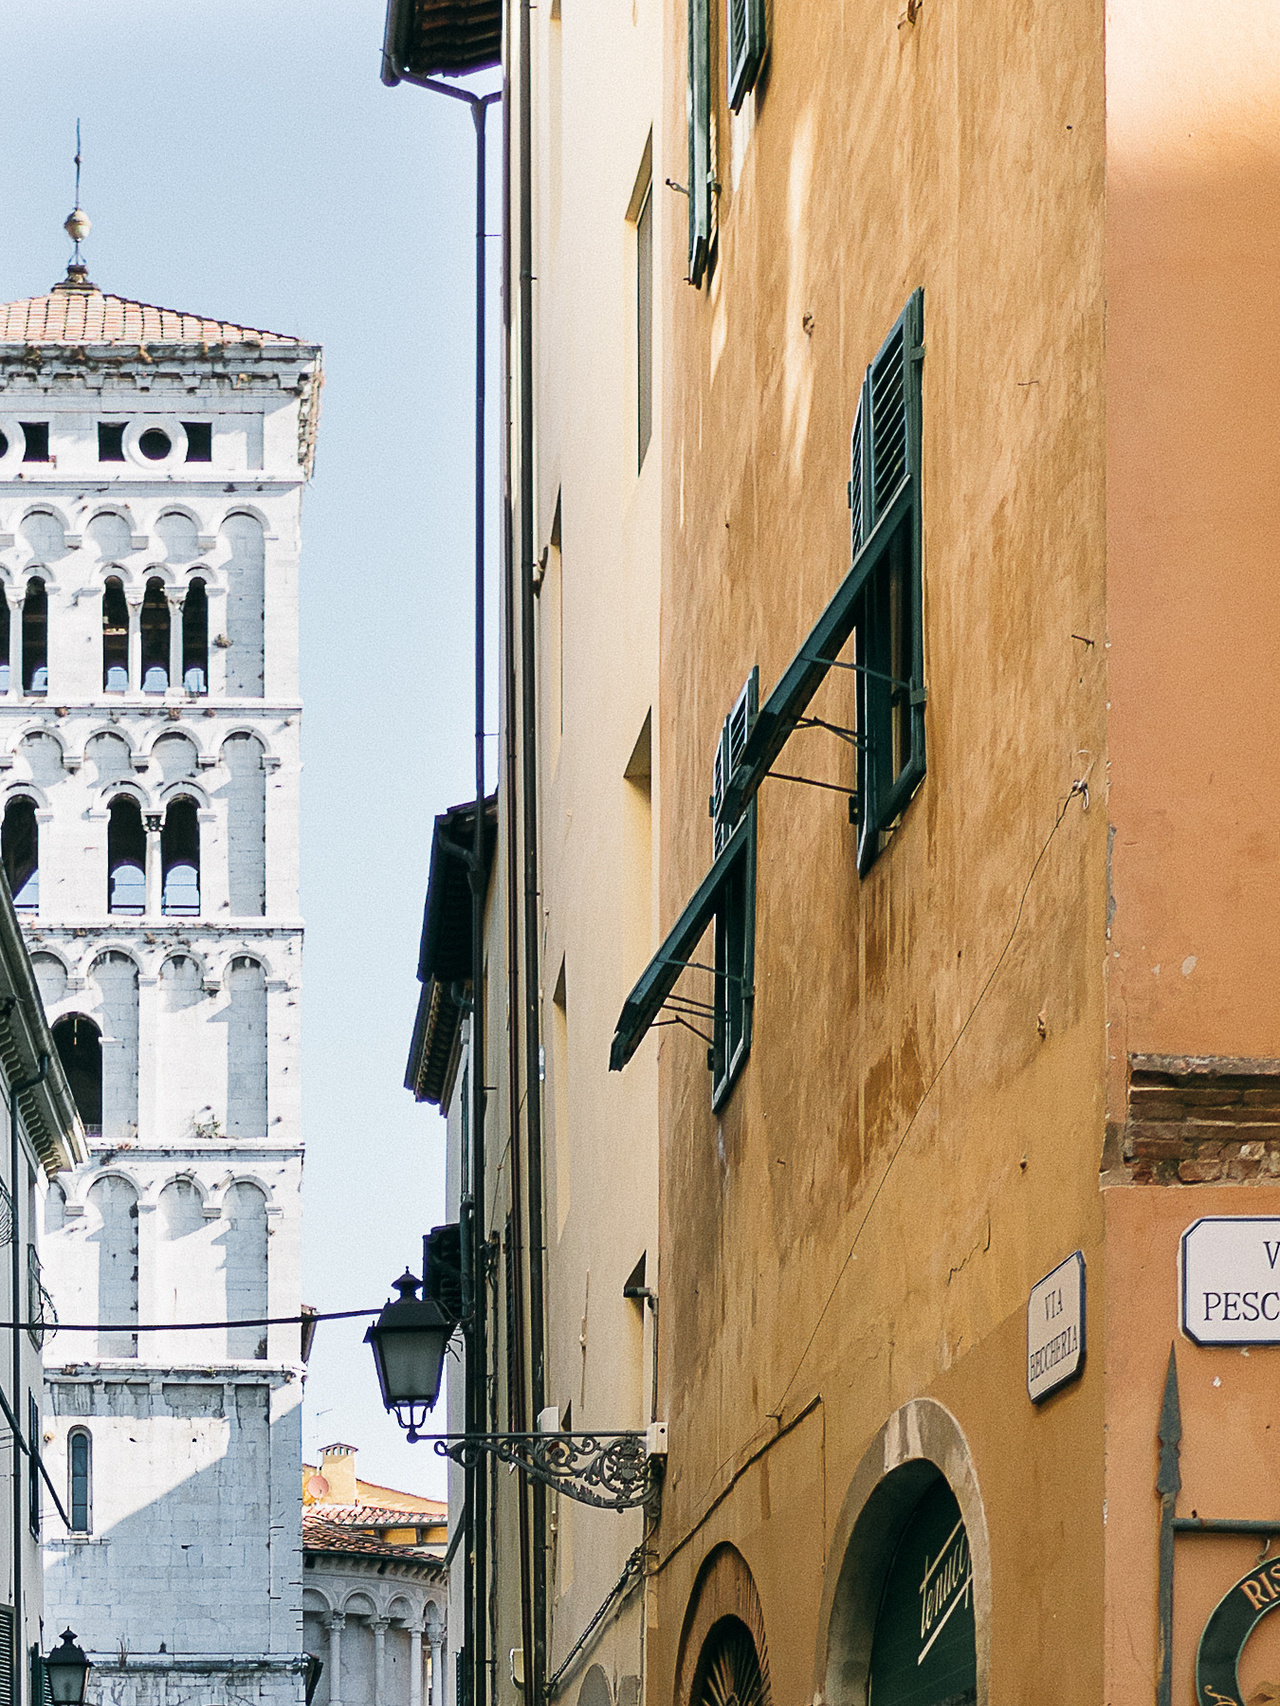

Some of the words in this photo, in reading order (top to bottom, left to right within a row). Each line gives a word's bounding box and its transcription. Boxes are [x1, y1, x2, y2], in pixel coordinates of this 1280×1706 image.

[1044, 1287, 1064, 1321] VIA
[1202, 1291, 1280, 1322] PESC
[1029, 1324, 1078, 1383] BECCHERIA
